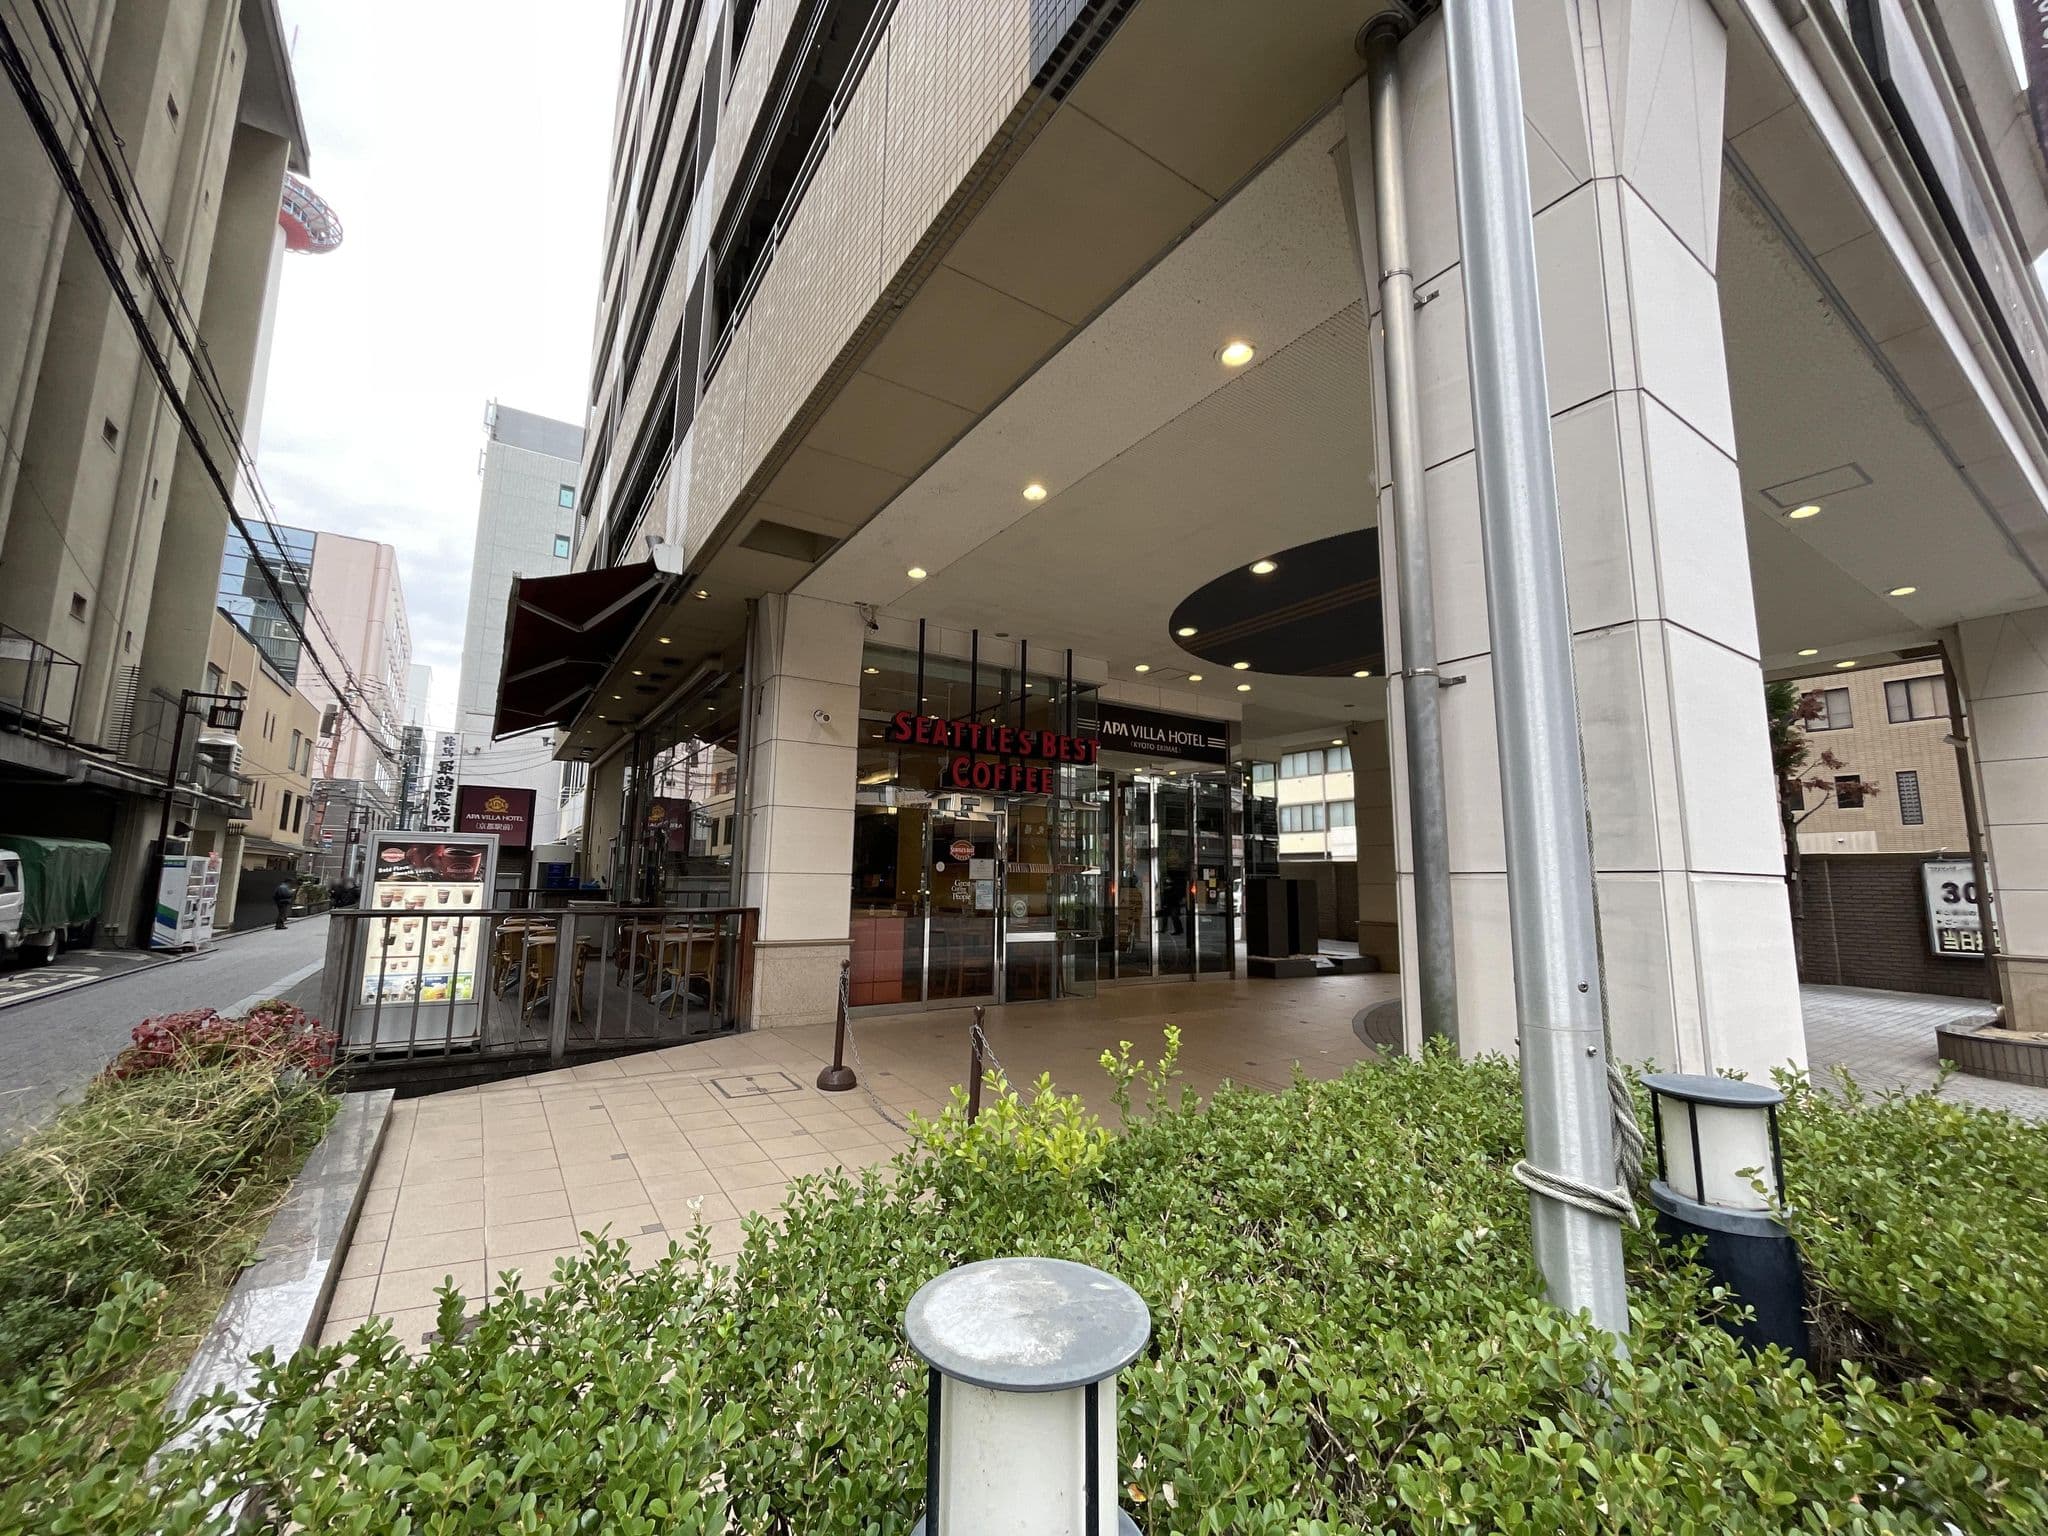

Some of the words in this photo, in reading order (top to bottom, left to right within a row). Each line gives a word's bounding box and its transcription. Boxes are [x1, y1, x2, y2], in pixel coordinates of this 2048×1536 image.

[895, 711, 1032, 755] SEATTLE'S
[1042, 730, 1099, 762] BEST
[1103, 721, 1129, 737] APA
[1131, 724, 1166, 742] VILLA
[1168, 730, 1206, 747] HOTEL
[952, 755, 1054, 794] COFFEE
